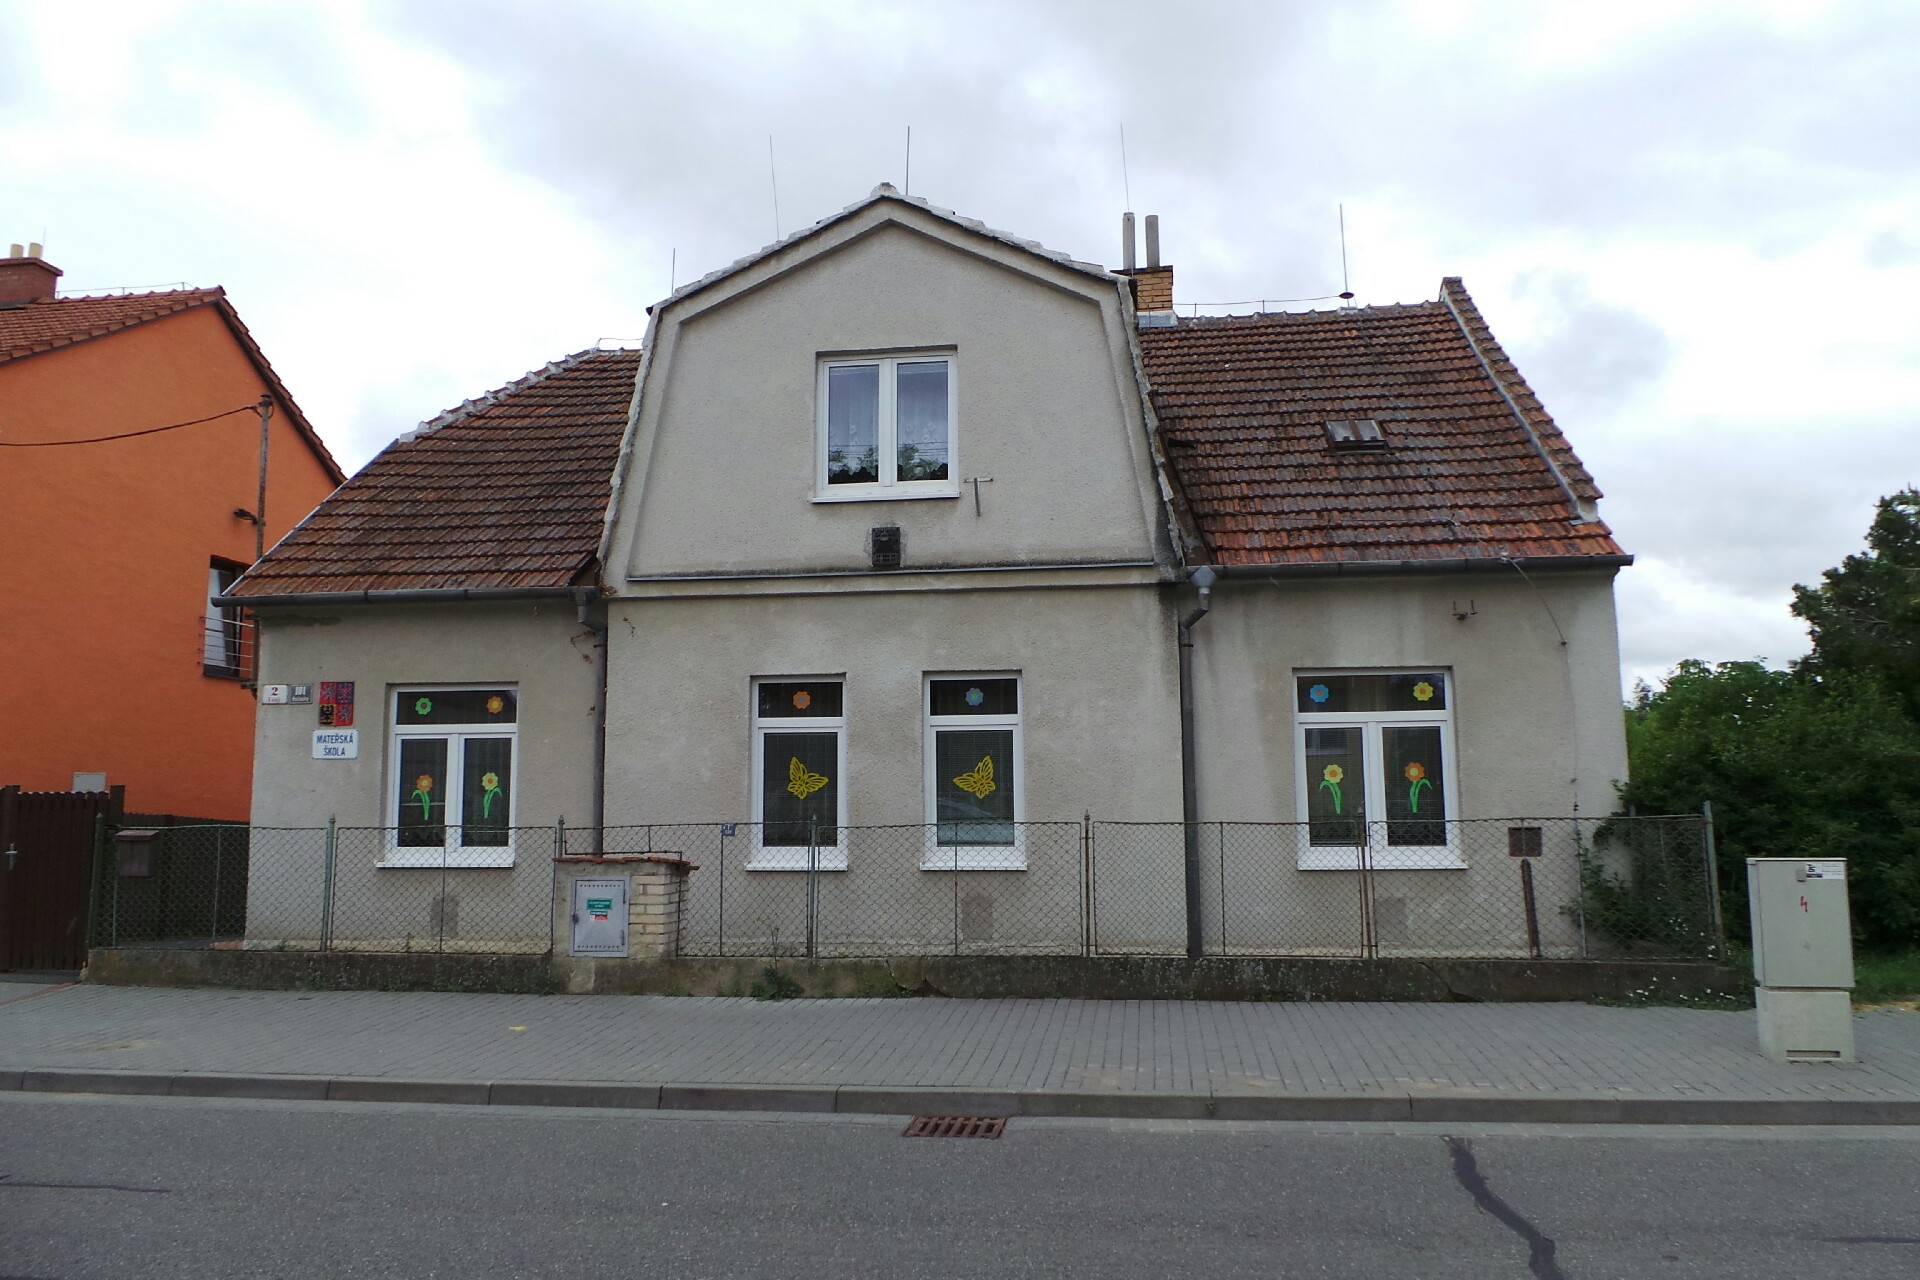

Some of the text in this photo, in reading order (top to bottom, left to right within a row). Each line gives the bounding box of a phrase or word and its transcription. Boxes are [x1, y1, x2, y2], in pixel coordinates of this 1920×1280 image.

[272, 687, 278, 696] 2
[316, 732, 353, 743] MATEŘSKÁ
[323, 745, 345, 756] ŠKOLA
